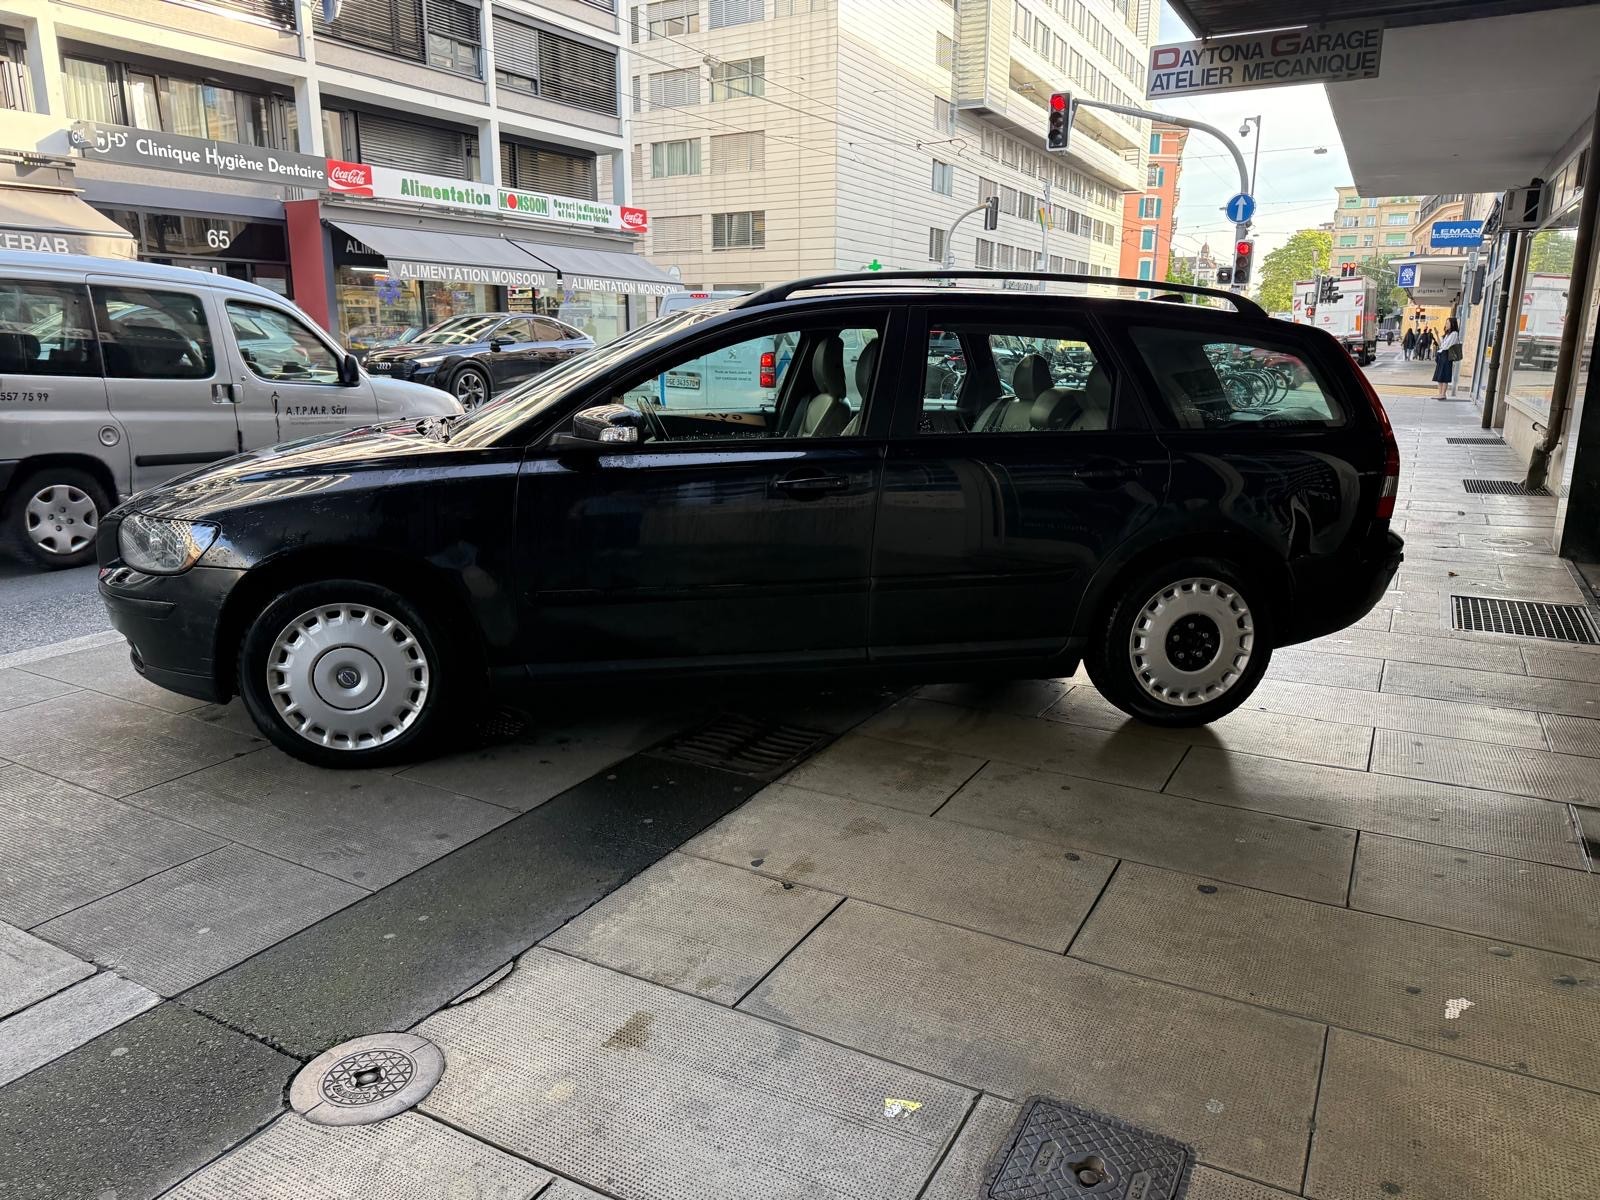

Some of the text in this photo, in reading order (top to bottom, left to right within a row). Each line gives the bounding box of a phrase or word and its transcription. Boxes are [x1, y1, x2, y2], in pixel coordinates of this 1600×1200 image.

[1152, 28, 1380, 70] DAYTONA GARAGE
[1150, 50, 1378, 92] ATELIER MECANIQUE
[136, 138, 324, 179] Clinique Hygiène Dentaire
[401, 178, 491, 206] Alimentation
[207, 229, 230, 249] 65
[1432, 228, 1480, 236] LEMAN
[400, 263, 546, 286] ALIMENTATION MONSOON
[571, 277, 636, 294] ALIMENTATION
[0, 392, 48, 401] 557 75 99
[286, 406, 329, 416] A.T.P.M.R.
